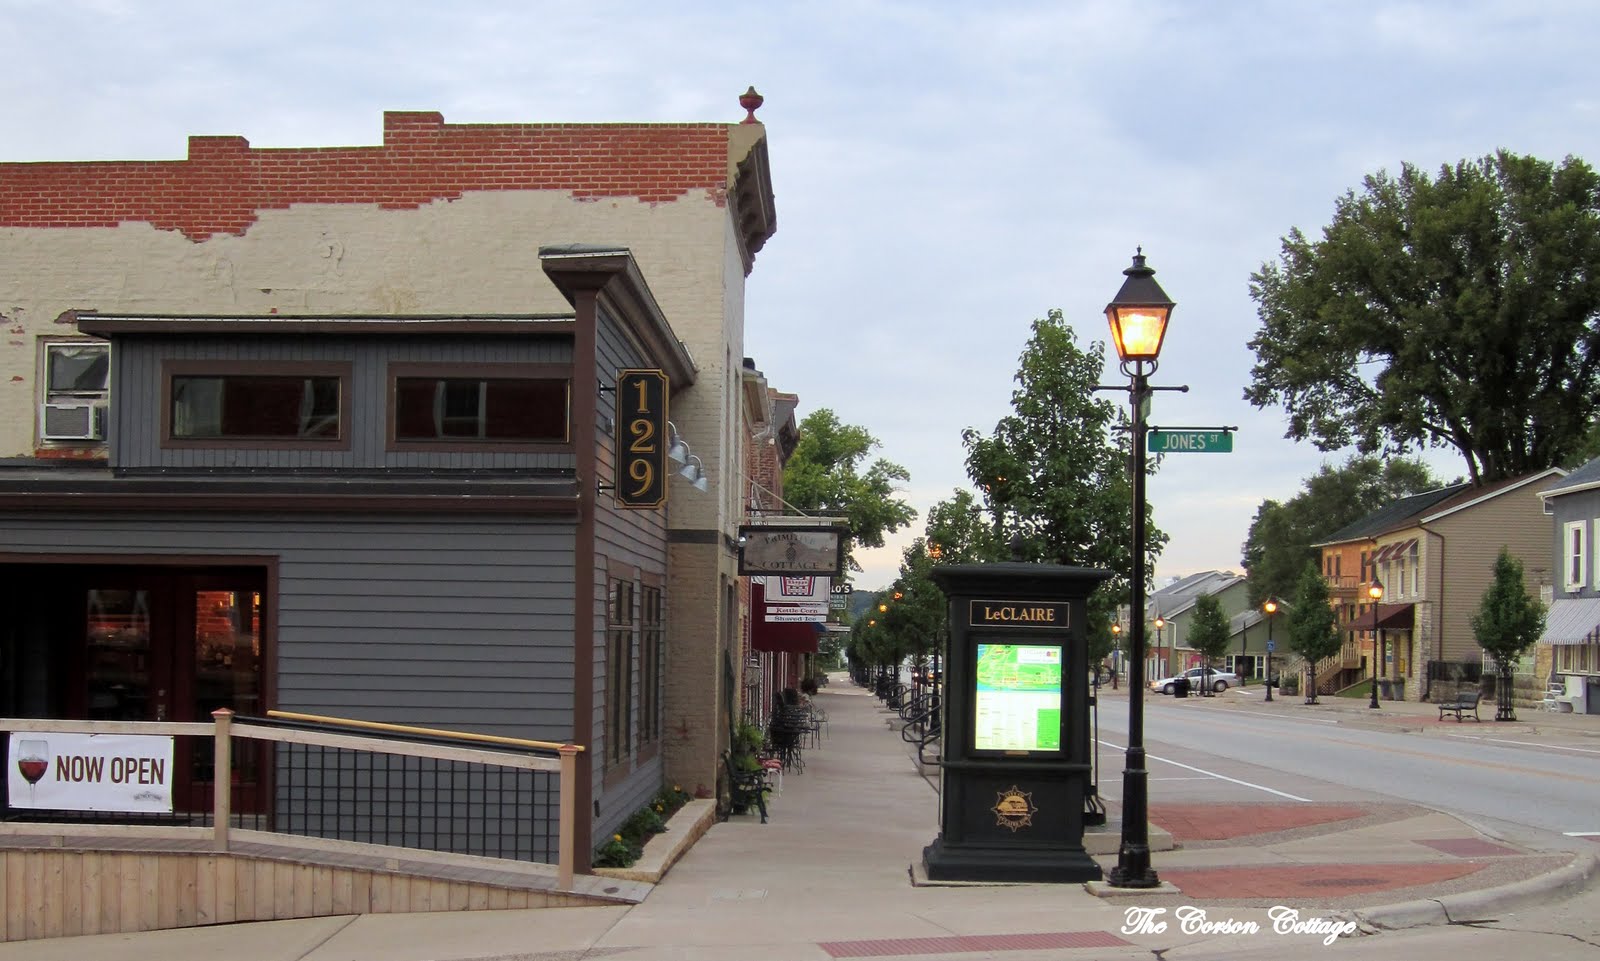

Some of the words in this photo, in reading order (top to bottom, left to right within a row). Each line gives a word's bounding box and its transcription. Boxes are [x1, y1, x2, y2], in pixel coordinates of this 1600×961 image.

[630, 379, 656, 497] 129
[1162, 434, 1206, 449] JONES
[1210, 434, 1219, 443] ST
[762, 561, 818, 569] COTTAGE
[985, 607, 1055, 621] LeCLAIRE
[56, 755, 104, 783] NOW
[110, 757, 165, 785] OPEN
